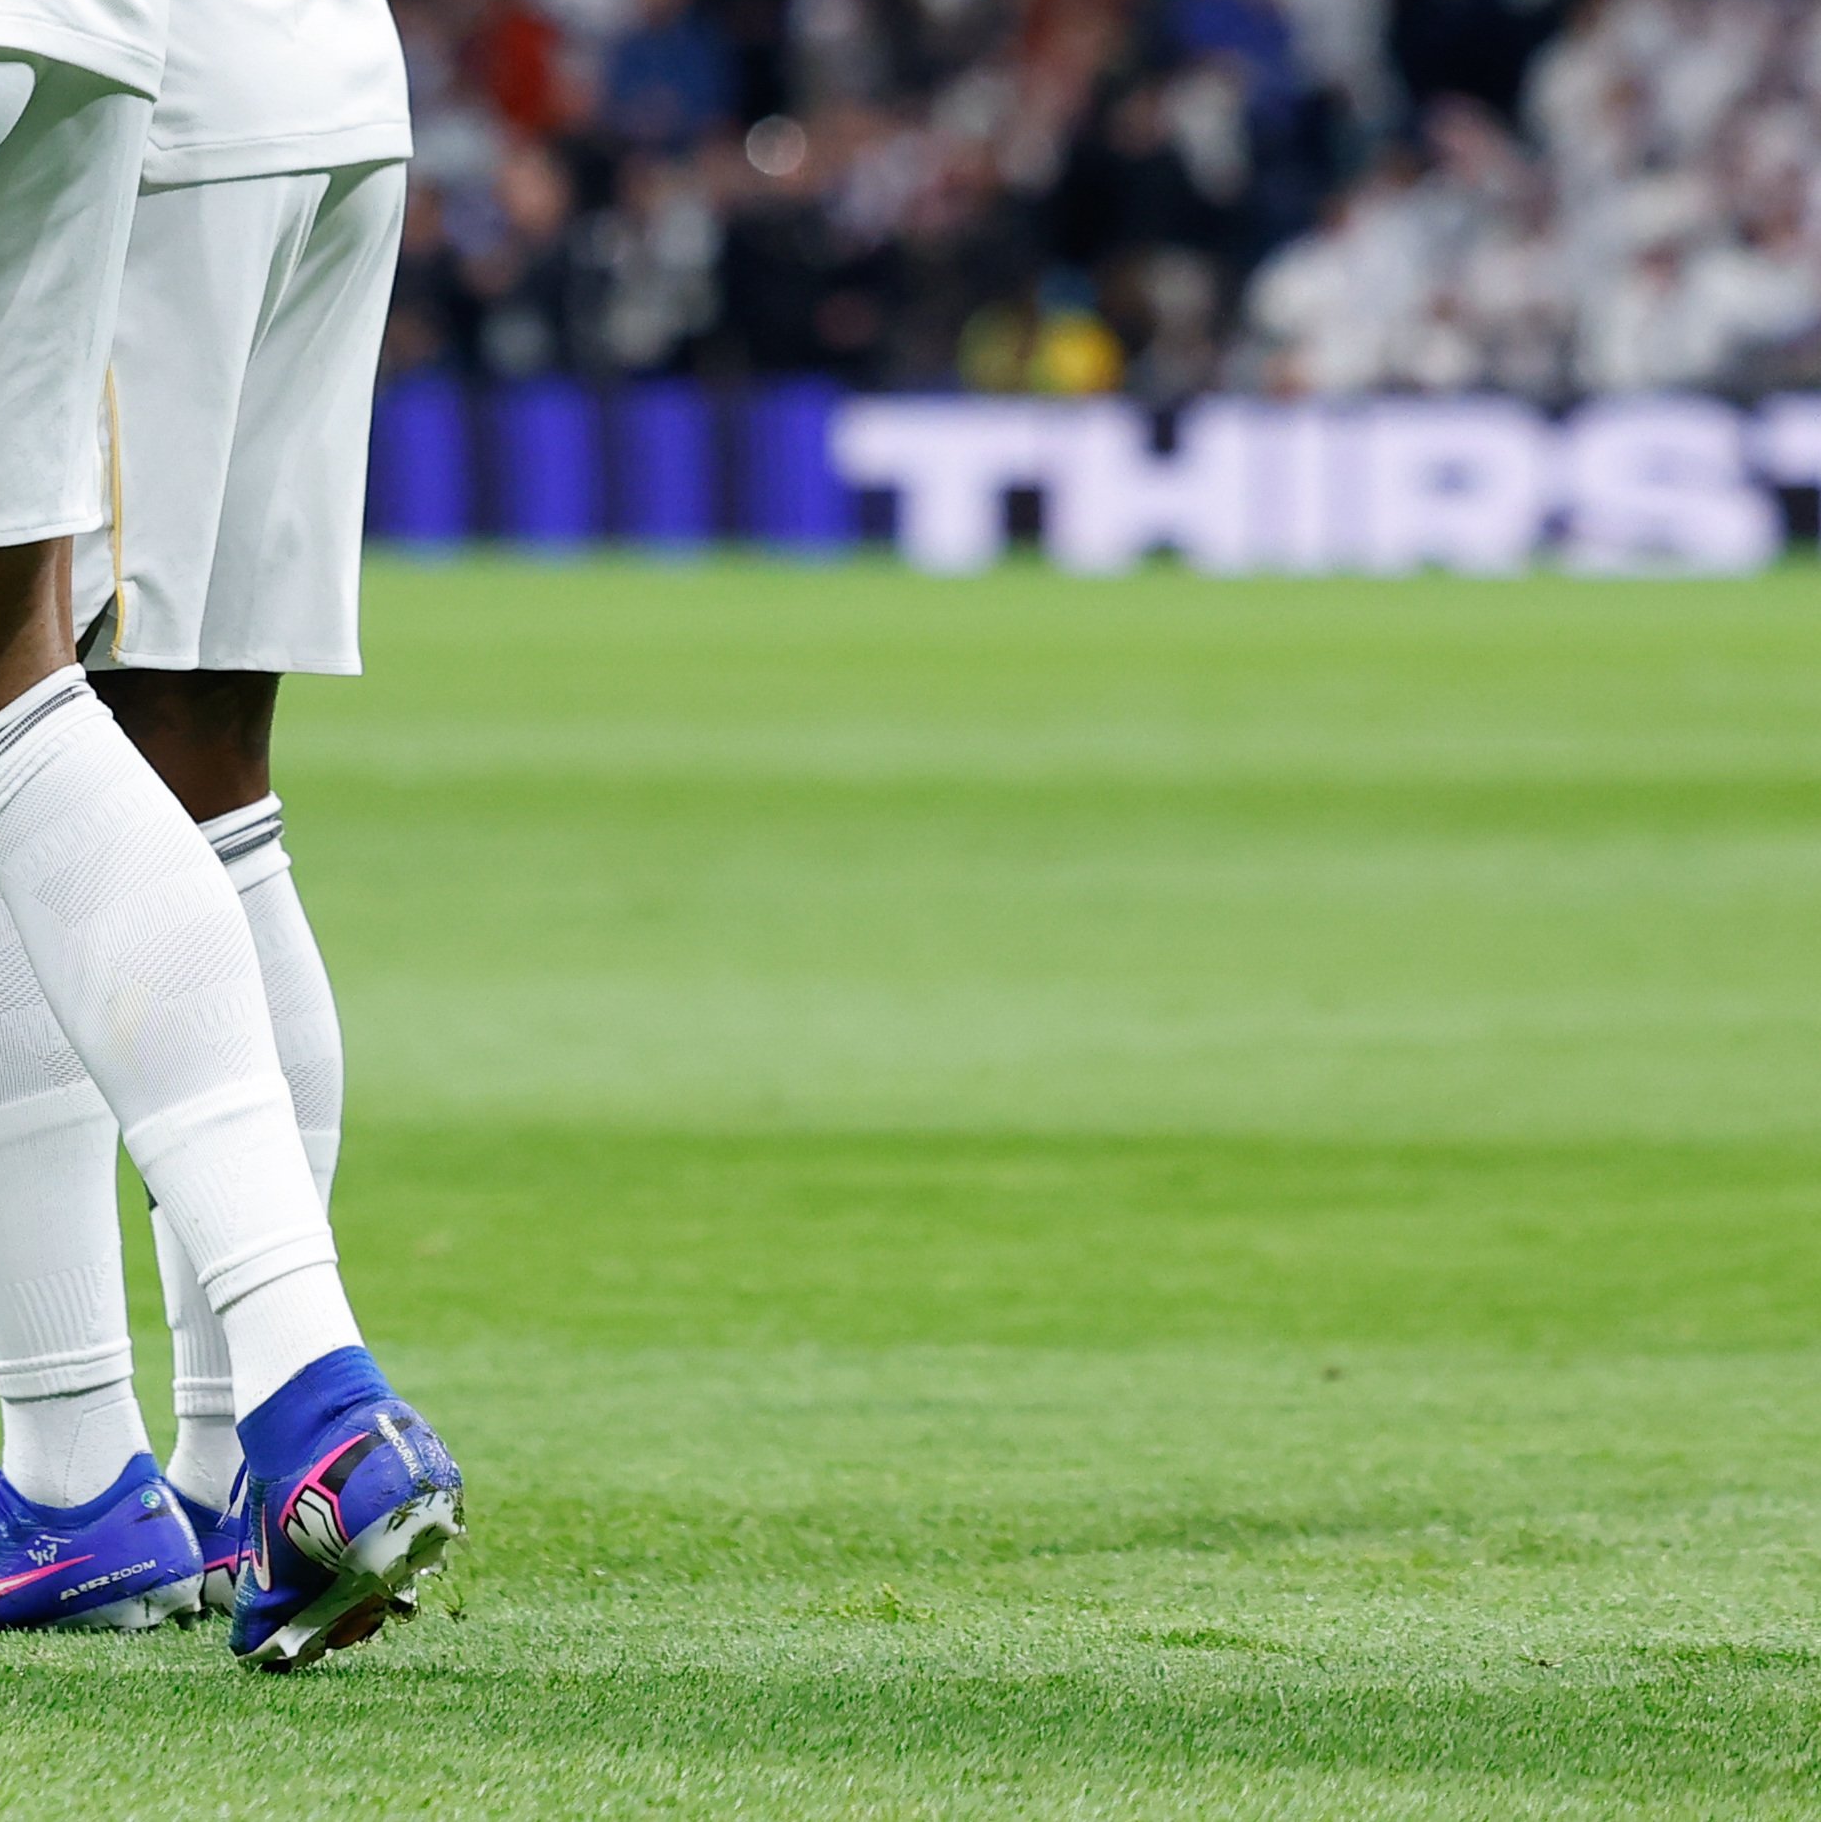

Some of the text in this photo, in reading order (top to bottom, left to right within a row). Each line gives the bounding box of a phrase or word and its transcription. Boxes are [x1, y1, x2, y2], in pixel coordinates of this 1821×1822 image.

[375, 1410, 422, 1479] MERCURIAL
[59, 1559, 158, 1602] AIR ZOOM
